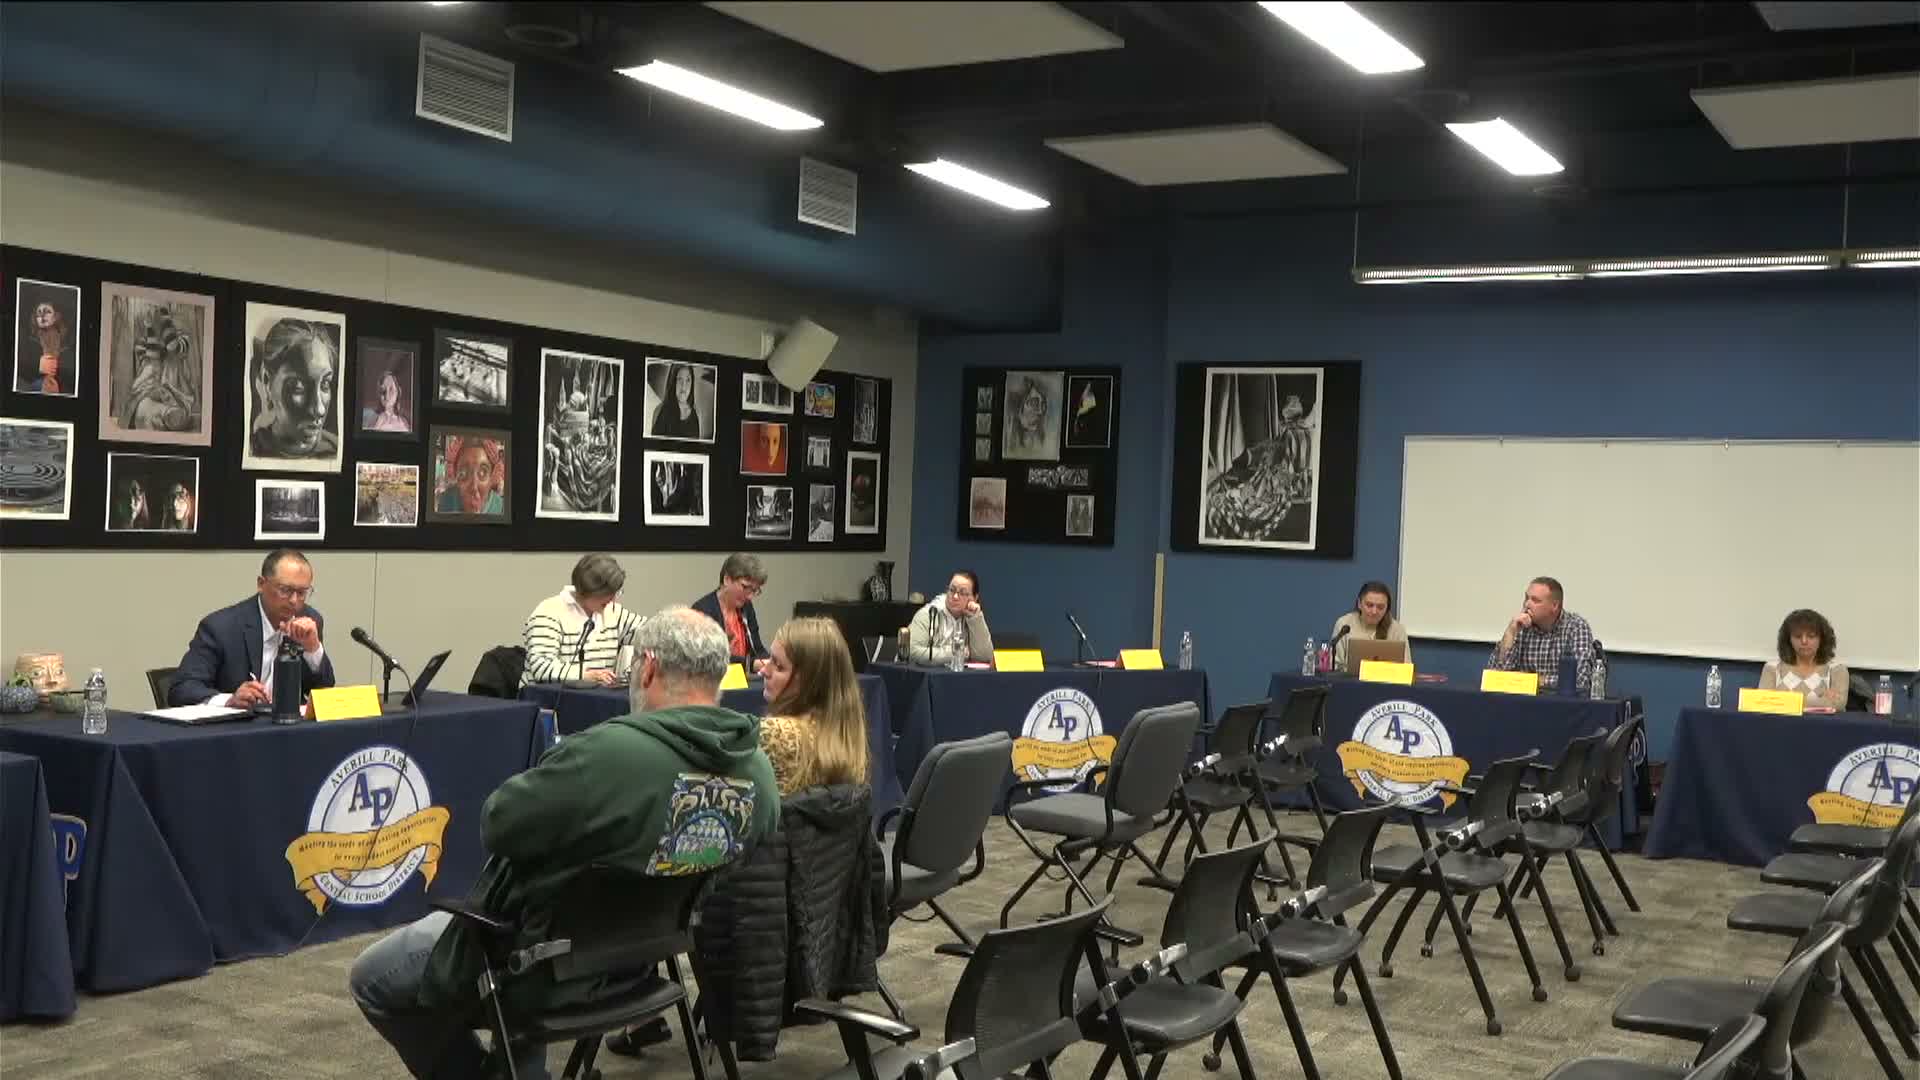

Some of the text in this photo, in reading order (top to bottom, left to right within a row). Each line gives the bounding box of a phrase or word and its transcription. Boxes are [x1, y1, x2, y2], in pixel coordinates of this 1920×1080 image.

[1037, 690, 1091, 710] AVERILL PARK
[1371, 702, 1439, 726] AVERILL PARK
[1048, 703, 1077, 741] AP
[1384, 714, 1421, 754] AP
[330, 749, 409, 788] AVERILL PARK
[1905, 748, 1920, 763] PA
[348, 769, 393, 827] AP
[1867, 757, 1915, 804] AP
[353, 888, 387, 903] SCHOOL
[387, 852, 419, 891] DISTRICT
